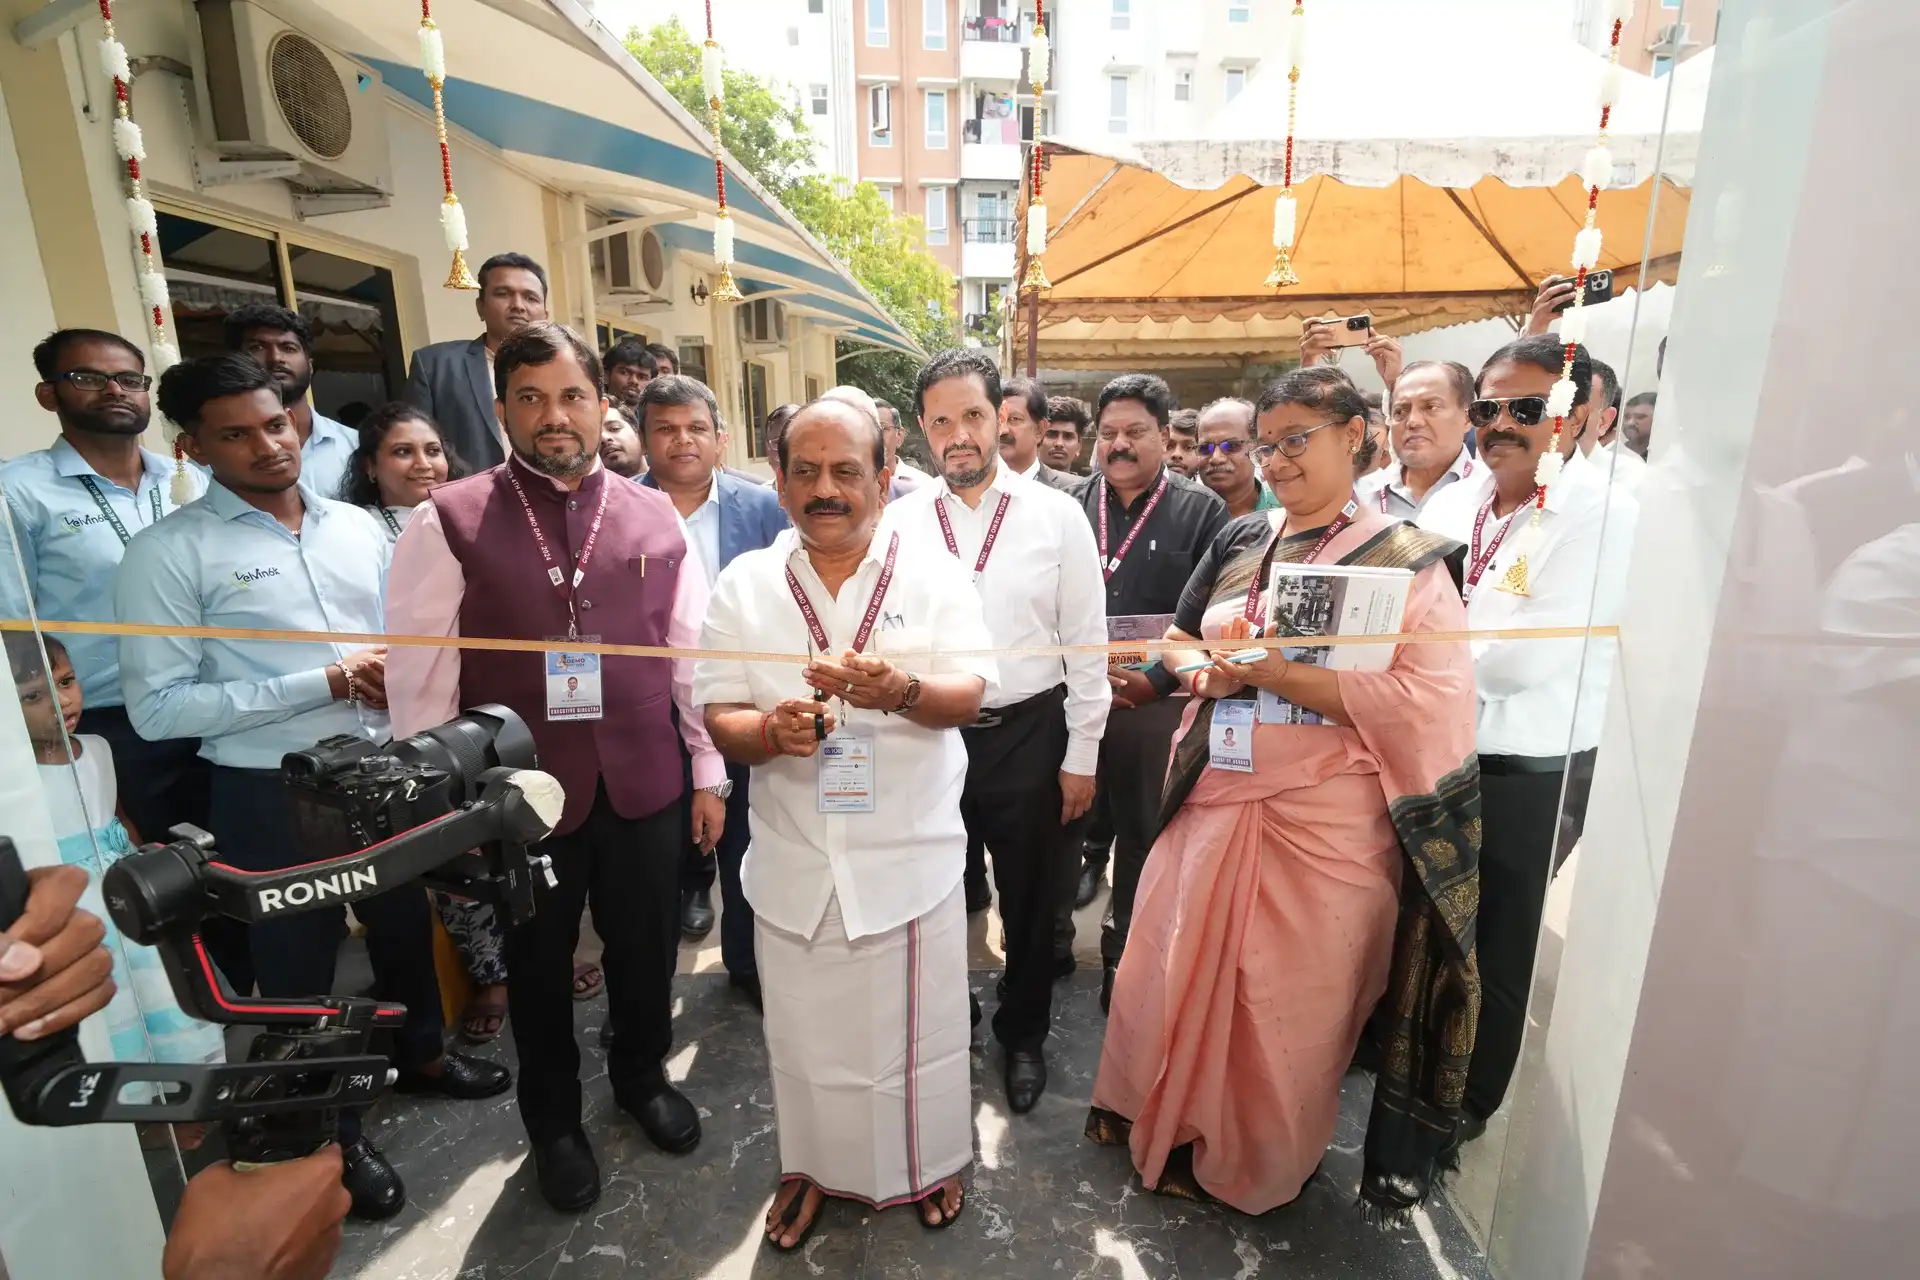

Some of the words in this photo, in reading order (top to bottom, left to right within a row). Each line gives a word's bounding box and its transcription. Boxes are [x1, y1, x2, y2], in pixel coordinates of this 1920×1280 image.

[89, 483, 104, 503] DEMO
[151, 489, 159, 505] MEGA
[102, 503, 117, 522] MEGA
[593, 515, 602, 532] MEGA
[598, 497, 608, 515] DEMO
[935, 500, 945, 516] DEMO
[997, 497, 1007, 514] MEGA
[511, 478, 520, 490] 4TH
[516, 489, 529, 507] MEGA
[524, 507, 538, 527] DEMO
[532, 526, 543, 541] DAY
[540, 545, 551, 561] 2024
[940, 516, 951, 534] MEGA
[990, 515, 1000, 532] DEMO
[1127, 529, 1136, 539] 4TH
[1133, 516, 1145, 530] MEGA
[1142, 502, 1153, 516] DEMO
[1150, 493, 1159, 502] DAY
[1472, 524, 1480, 545] MEGA
[1476, 503, 1487, 524] DEMO
[946, 534, 954, 545] 4TH
[985, 533, 993, 546] DAY
[1315, 538, 1326, 551] DAY
[1329, 520, 1342, 535] 2024
[978, 550, 986, 564] 2024
[1486, 544, 1496, 558] DAY
[1475, 562, 1486, 578] 2024
[868, 606, 877, 622] 4TH
[873, 587, 884, 606] MEGA
[882, 566, 892, 585] DEMO
[793, 585, 806, 603] DEMO
[803, 603, 814, 619] DAY
[812, 624, 824, 642] 2024
[259, 865, 377, 913] RONIN
